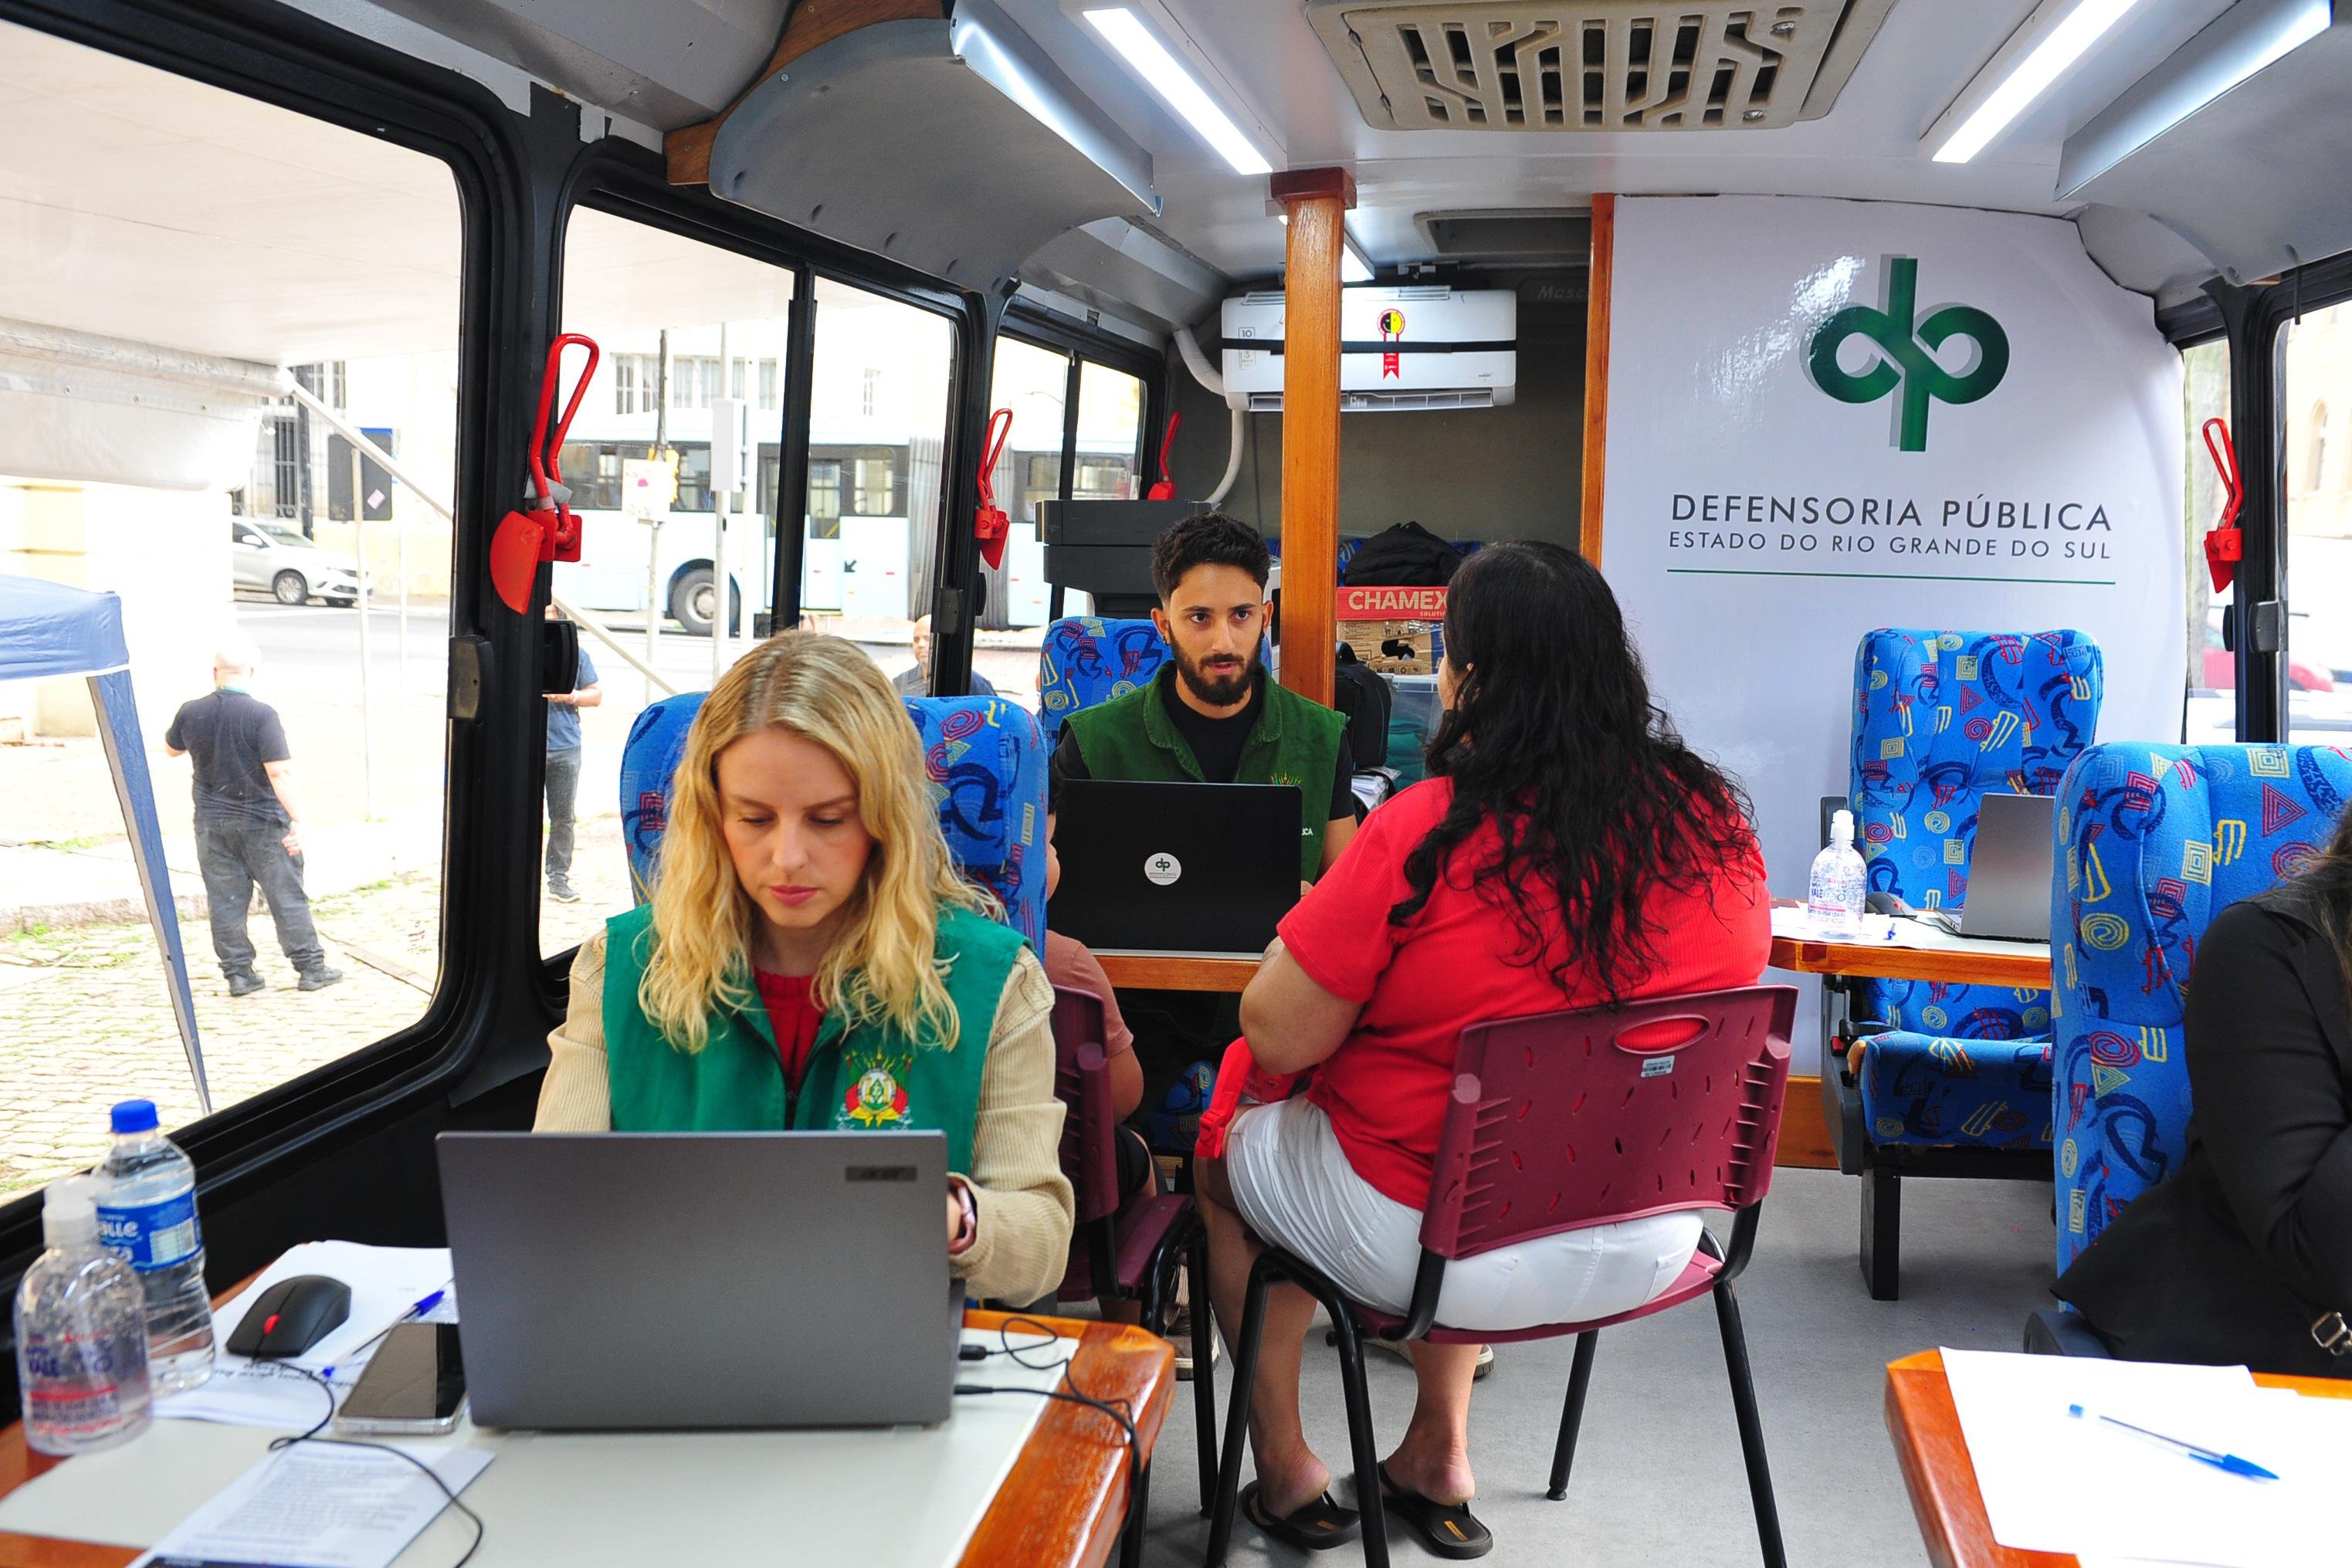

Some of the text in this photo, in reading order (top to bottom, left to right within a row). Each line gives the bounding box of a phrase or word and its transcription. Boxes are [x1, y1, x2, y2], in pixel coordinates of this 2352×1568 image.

[1242, 330, 1252, 338] 10
[1672, 493, 2112, 531] DEFENSORIA PÚBLICA
[1669, 531, 2110, 558] ESTADO DO RIO GRANDE DO SUL
[1348, 591, 1447, 610] CHAMEX
